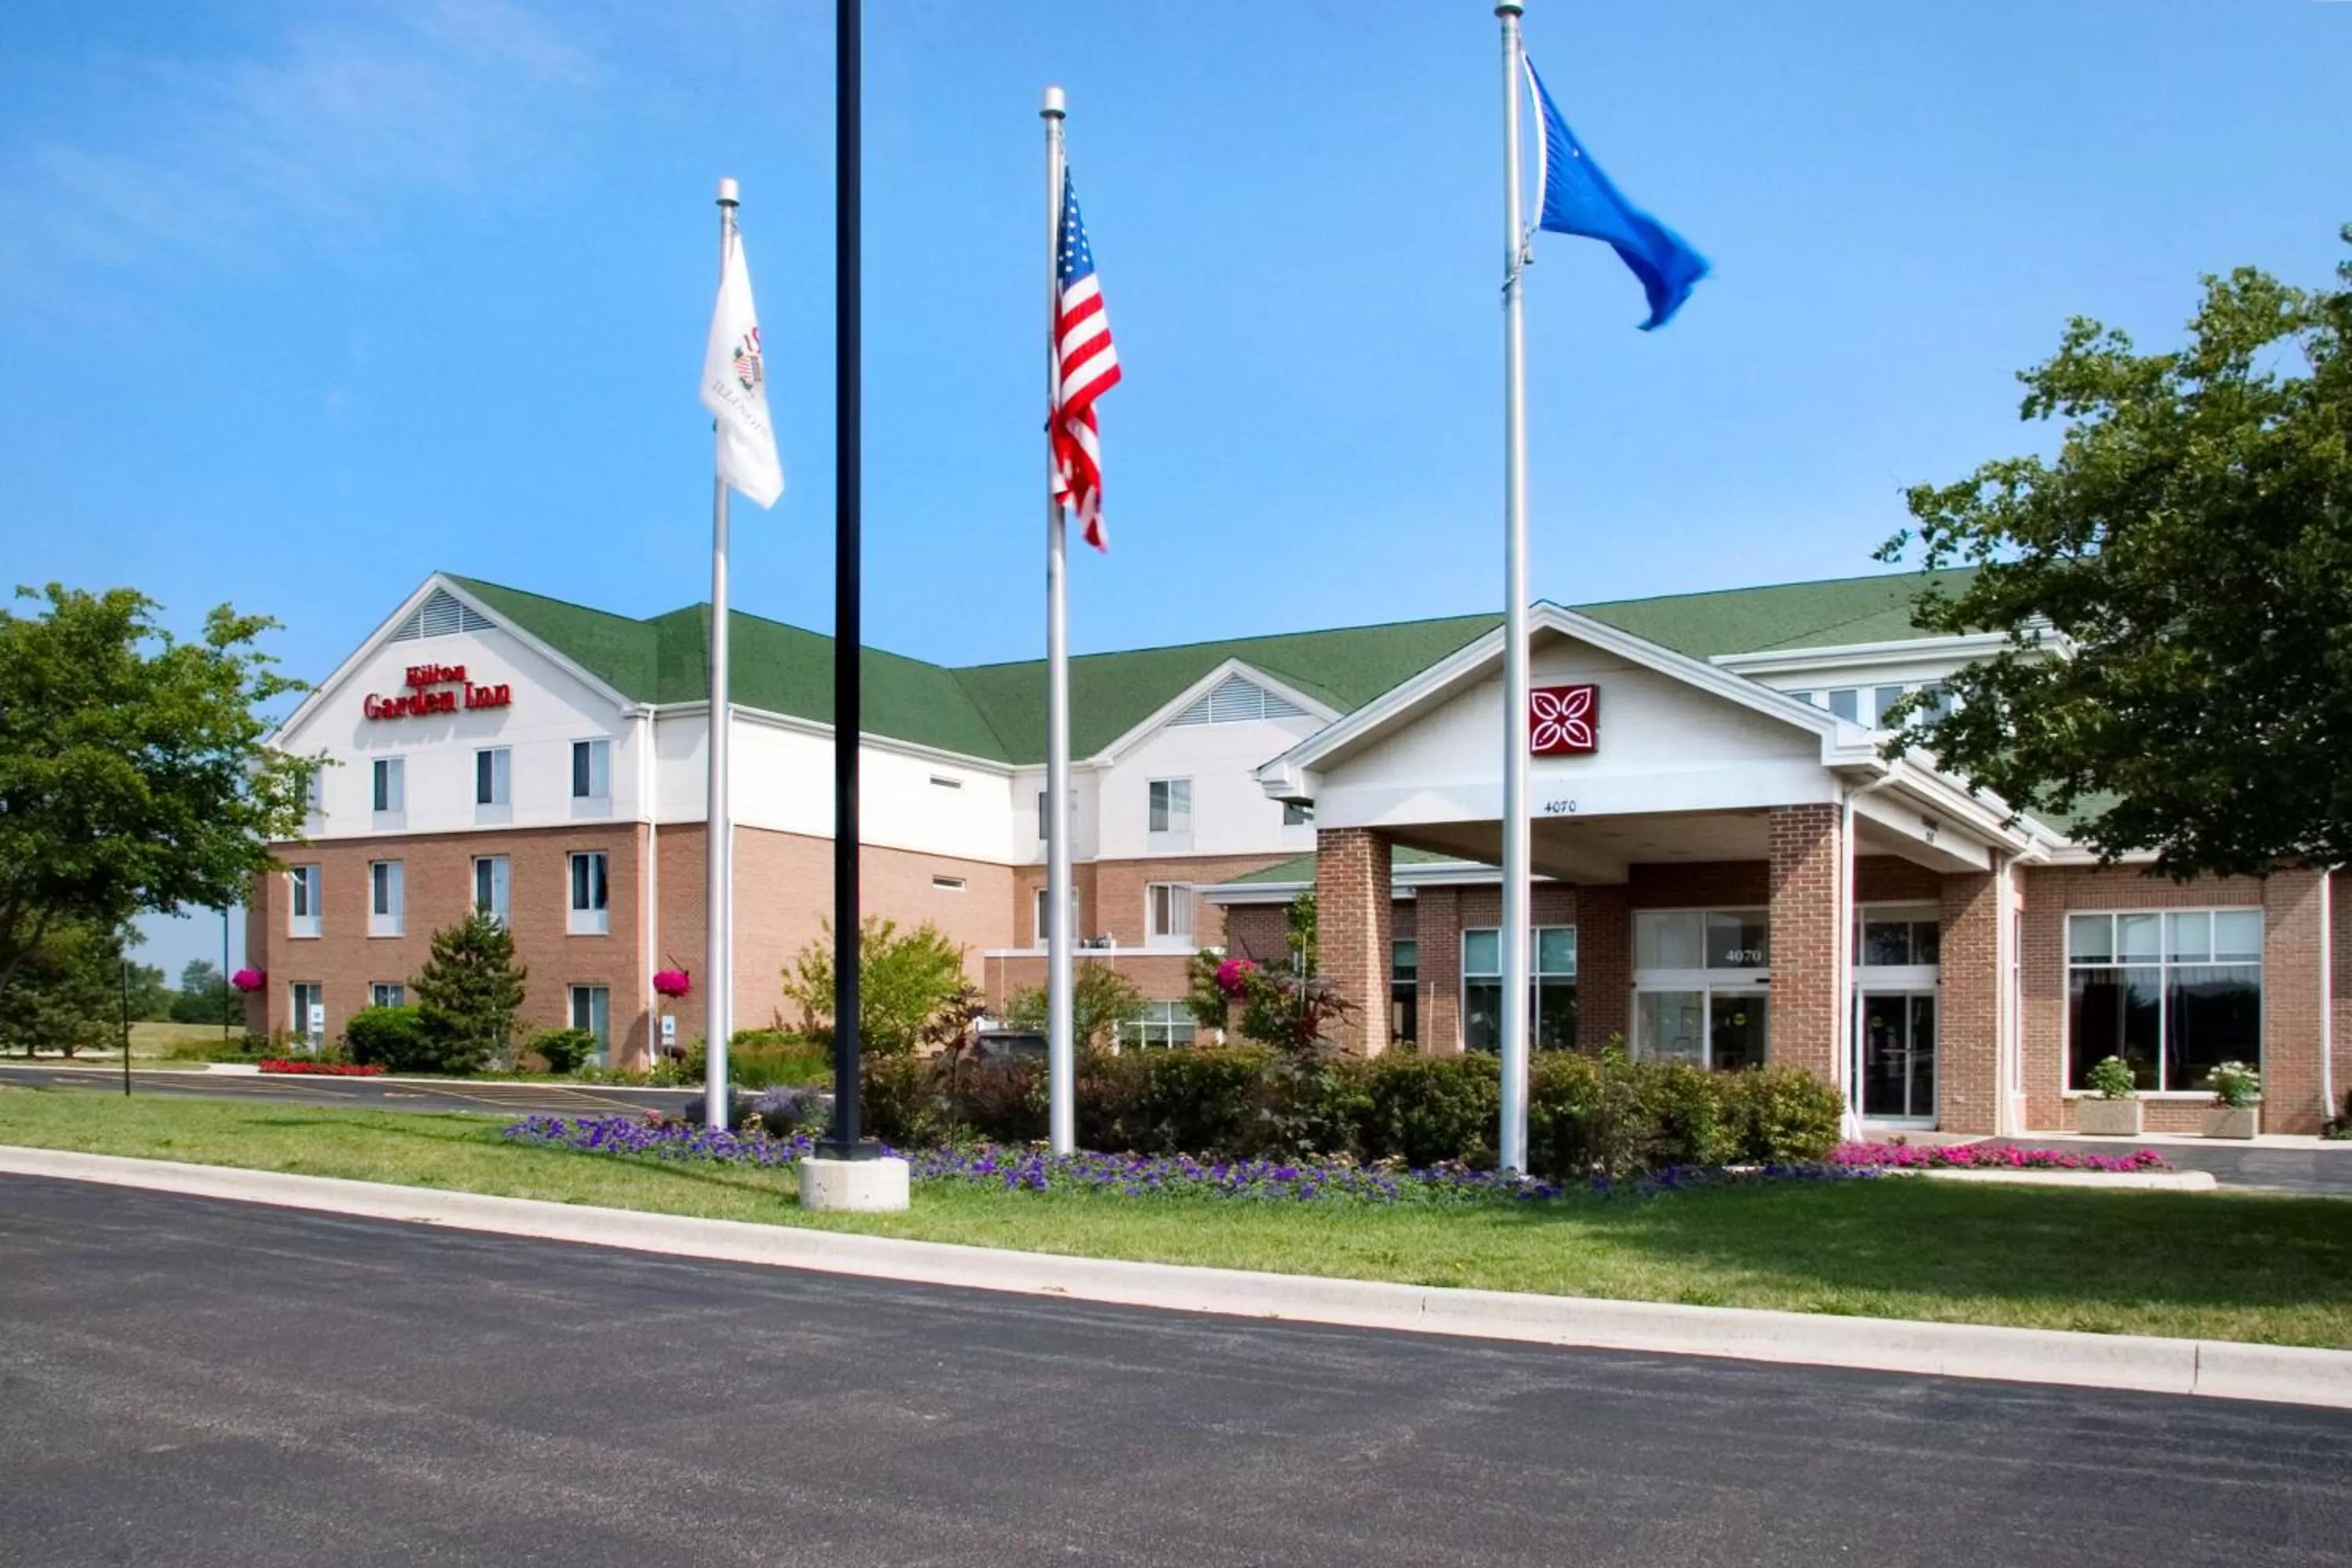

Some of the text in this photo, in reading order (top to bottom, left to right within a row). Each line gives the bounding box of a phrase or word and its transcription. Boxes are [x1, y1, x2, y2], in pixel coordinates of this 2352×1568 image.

[405, 664, 467, 688] Hilton
[364, 681, 512, 720] Garden Inn
[1544, 800, 1577, 813] 4070
[1725, 949, 1762, 962] 4070
